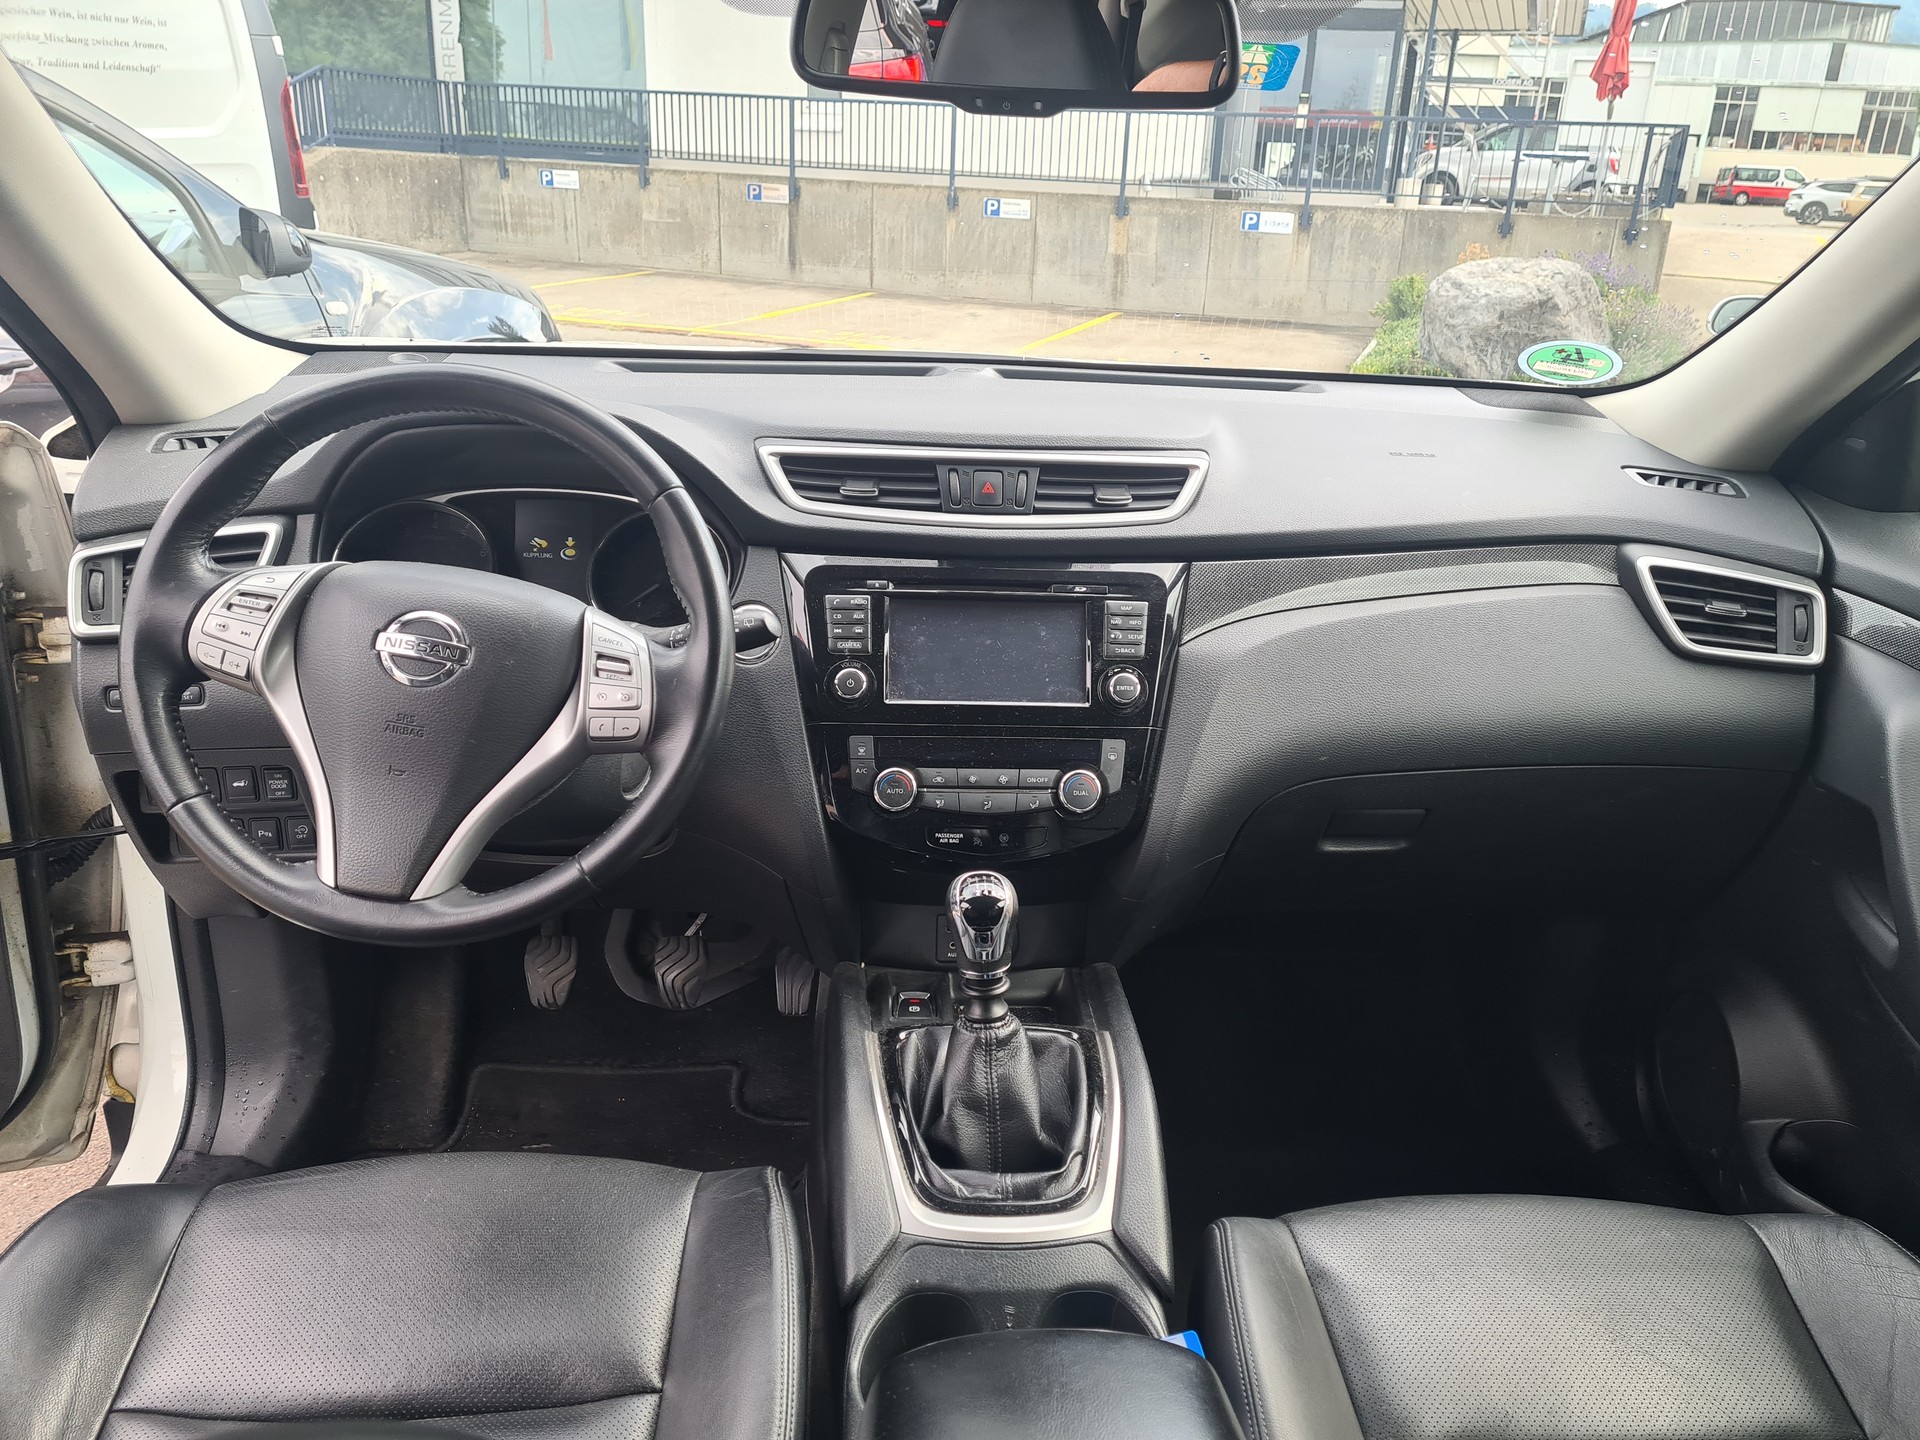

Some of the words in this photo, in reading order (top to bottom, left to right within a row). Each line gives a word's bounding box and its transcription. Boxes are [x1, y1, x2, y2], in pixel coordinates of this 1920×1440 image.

[49, 8, 75, 20] Wein,
[77, 10, 88, 20] ist
[90, 12, 112, 22] nicht
[114, 15, 129, 24] nur
[132, 15, 156, 27] Wein,
[157, 18, 167, 27] ist
[44, 32, 89, 46] Mischung
[92, 36, 130, 47] zwischen
[132, 40, 168, 51] Aromen,
[37, 56, 79, 69] Tradition
[82, 60, 100, 70] und
[542, 171, 552, 185] P
[750, 185, 759, 199] P
[987, 199, 998, 215] P
[1245, 213, 1257, 230] P
[238, 598, 261, 607] ENTER
[384, 636, 460, 660] NISSAN
[597, 636, 624, 647] CANCEL
[396, 713, 416, 724] SRS
[384, 723, 425, 738] AIRBAG
